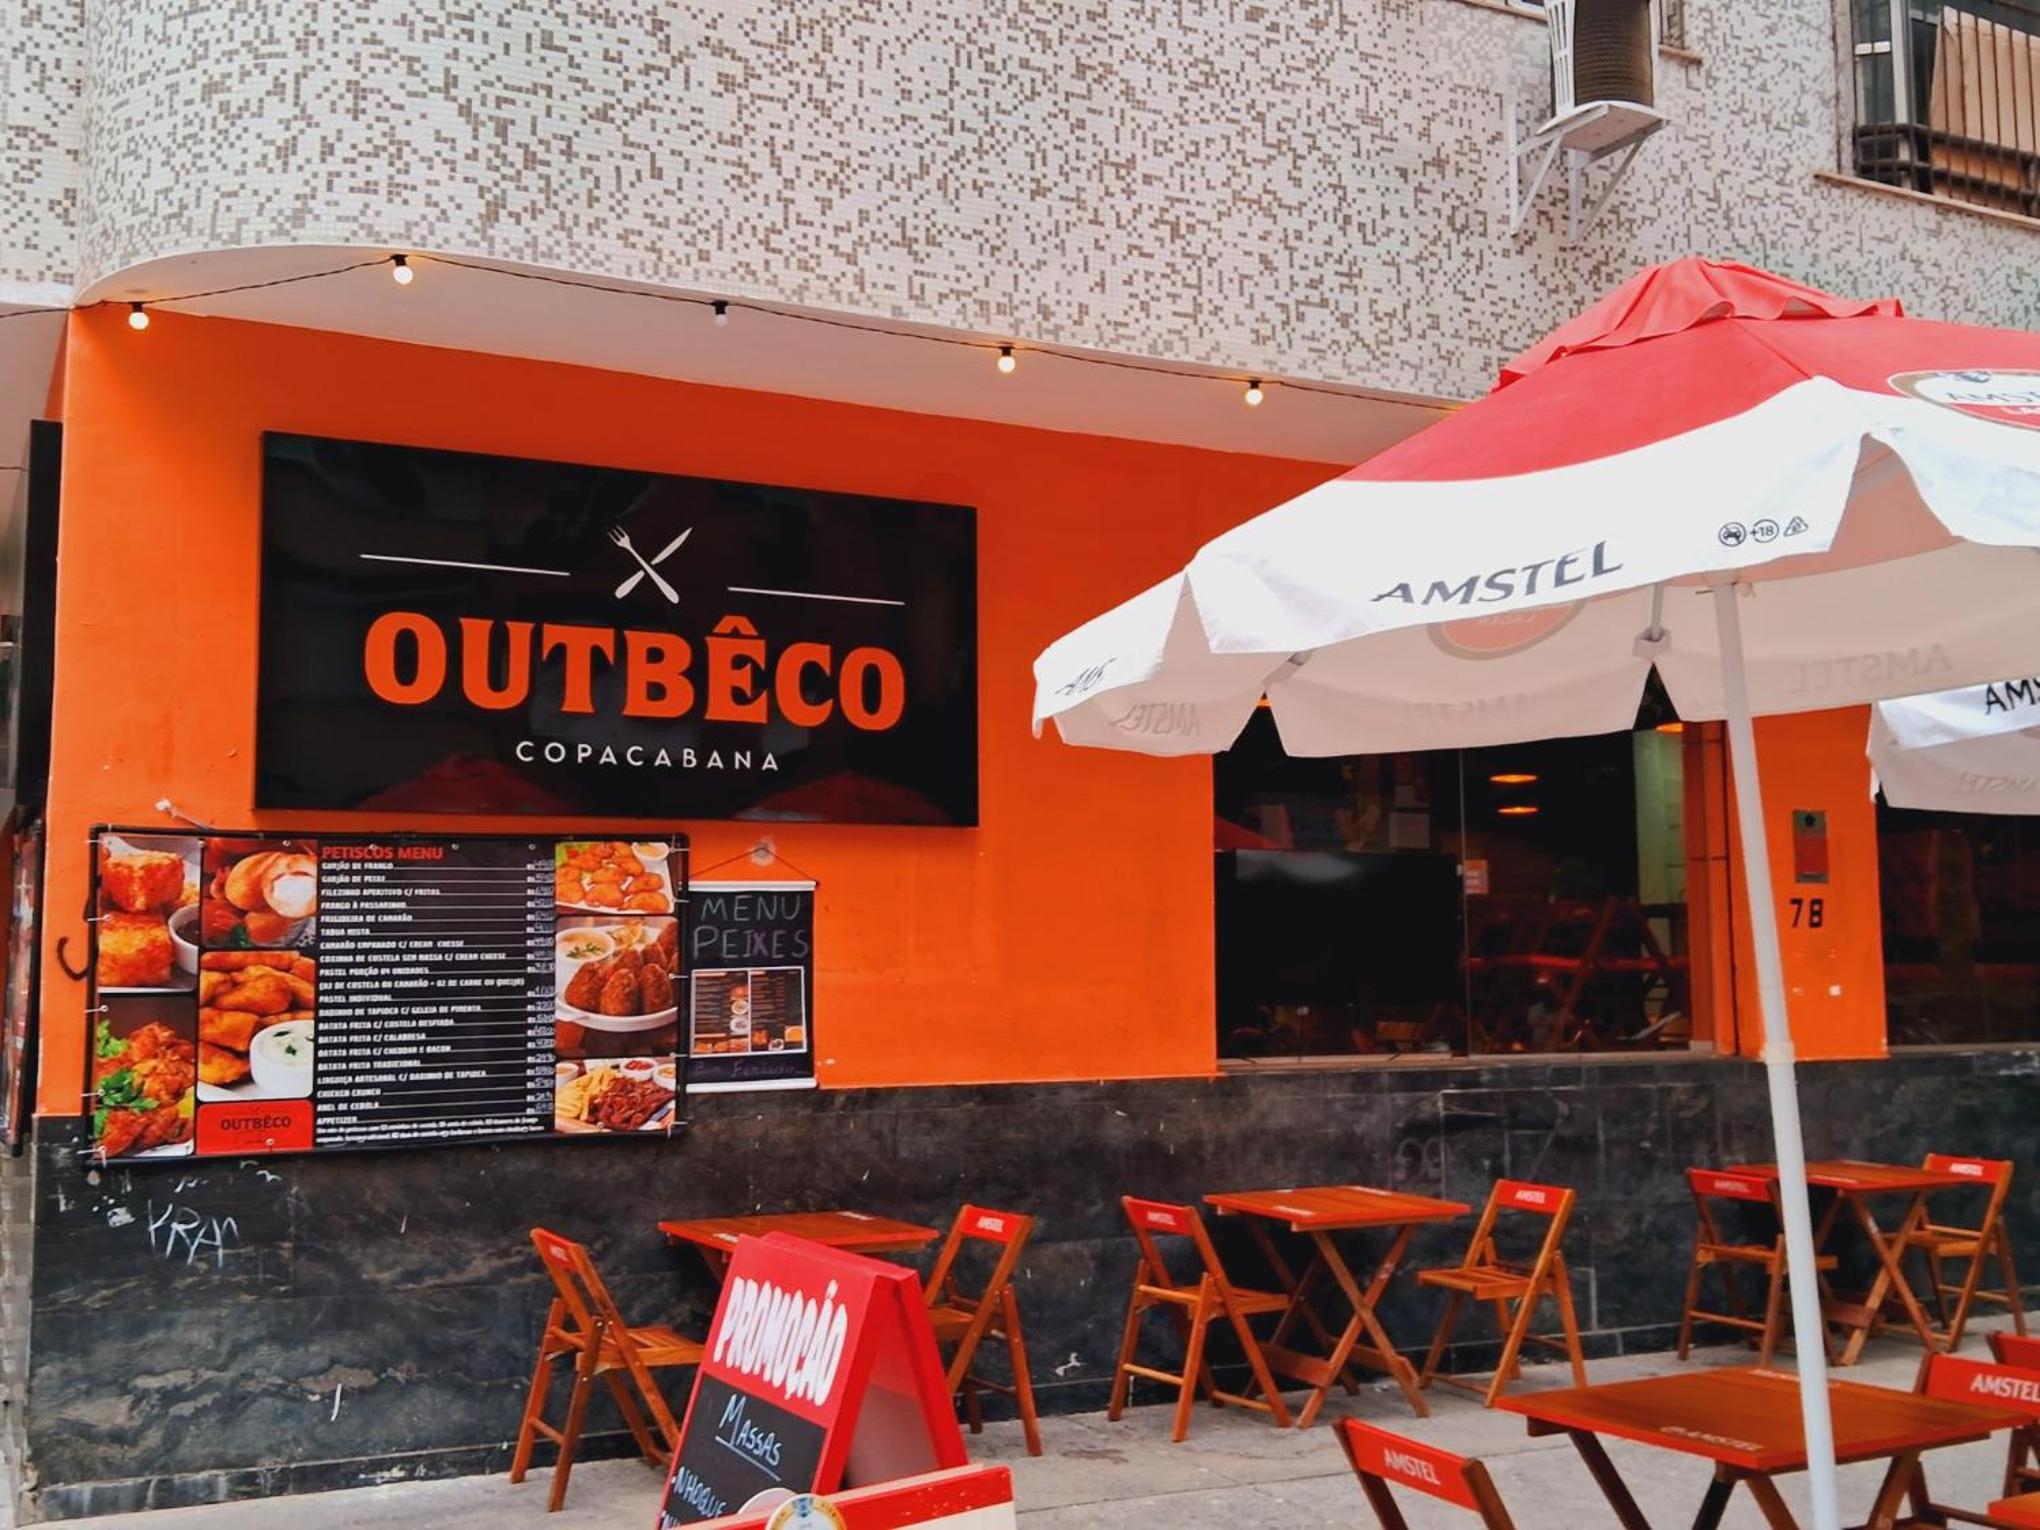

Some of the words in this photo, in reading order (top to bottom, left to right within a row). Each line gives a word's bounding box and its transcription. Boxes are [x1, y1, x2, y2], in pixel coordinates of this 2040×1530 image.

[1371, 541, 1623, 605] AMSTEL
[363, 611, 905, 731] OUTBÊCO
[516, 741, 780, 772] COPACABANA
[398, 847, 443, 860] MENU
[701, 894, 801, 922] MENU
[1790, 898, 1823, 928] 78
[693, 925, 809, 960] PEIXES
[1384, 1448, 1442, 1486] AMSTEL
